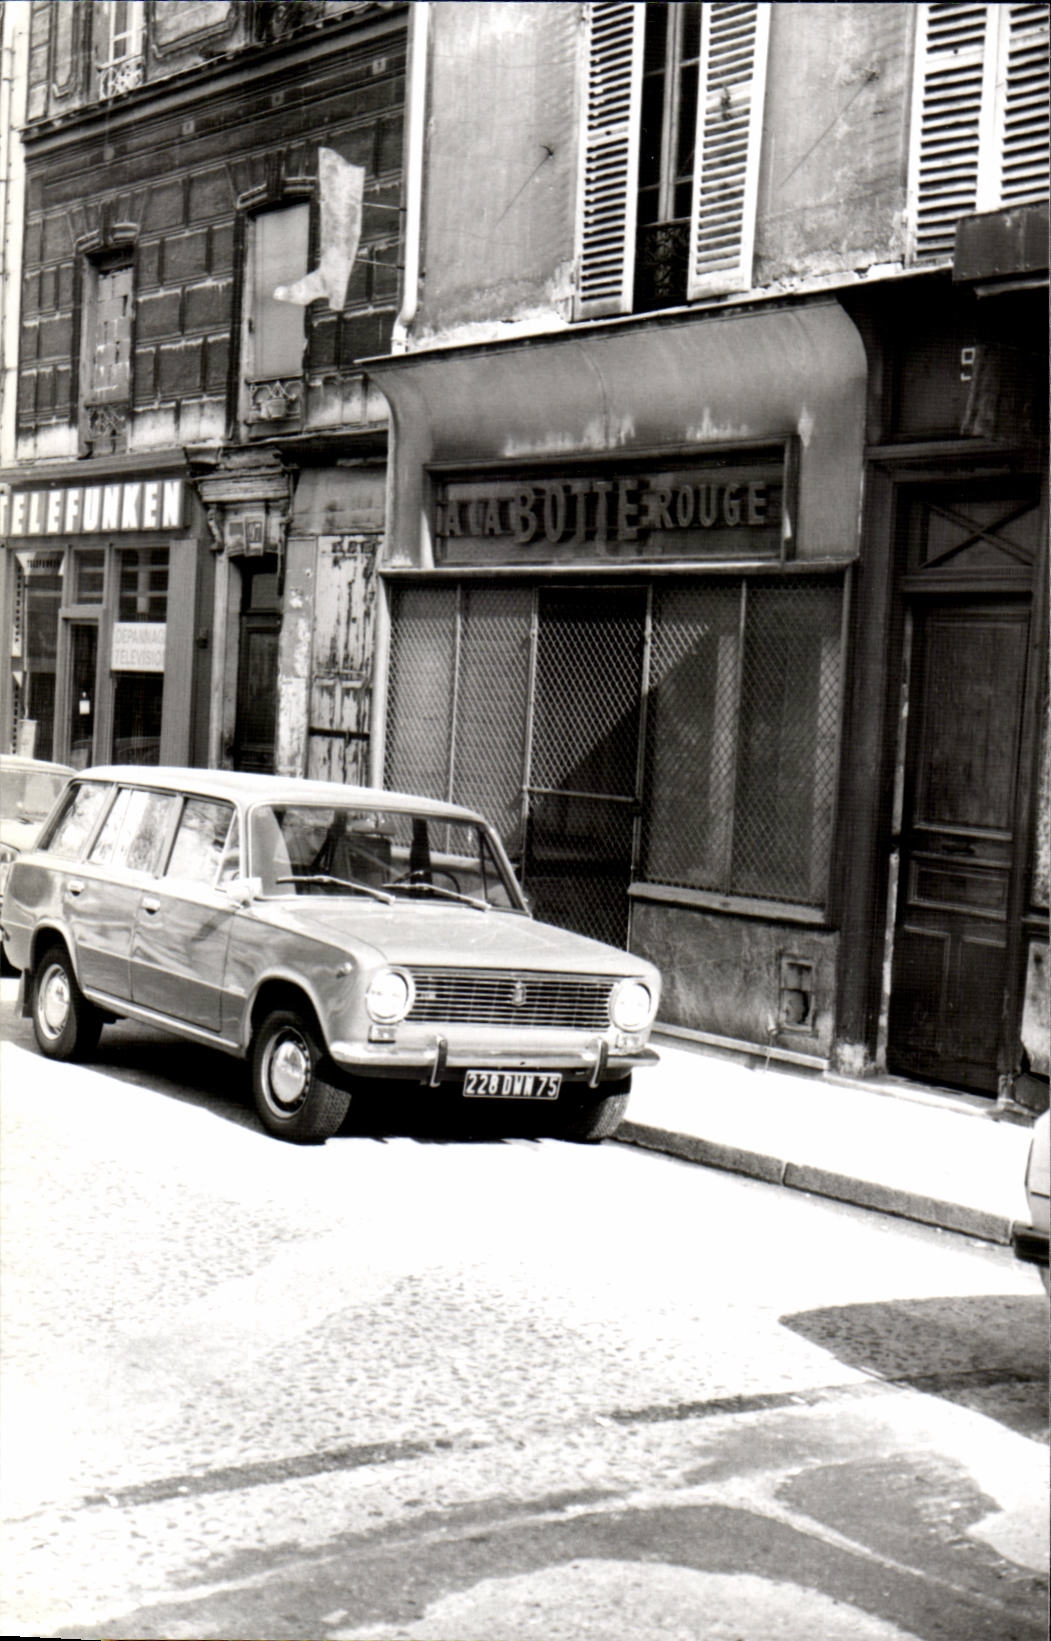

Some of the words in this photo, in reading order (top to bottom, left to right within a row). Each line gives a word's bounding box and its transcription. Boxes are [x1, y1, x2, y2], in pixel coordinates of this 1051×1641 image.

[445, 499, 461, 535] A
[469, 498, 501, 535] LA
[512, 479, 639, 543] BOTTE
[655, 481, 767, 529] ROUGE
[466, 1074, 499, 1095] 228
[536, 1076, 558, 1097] 75
